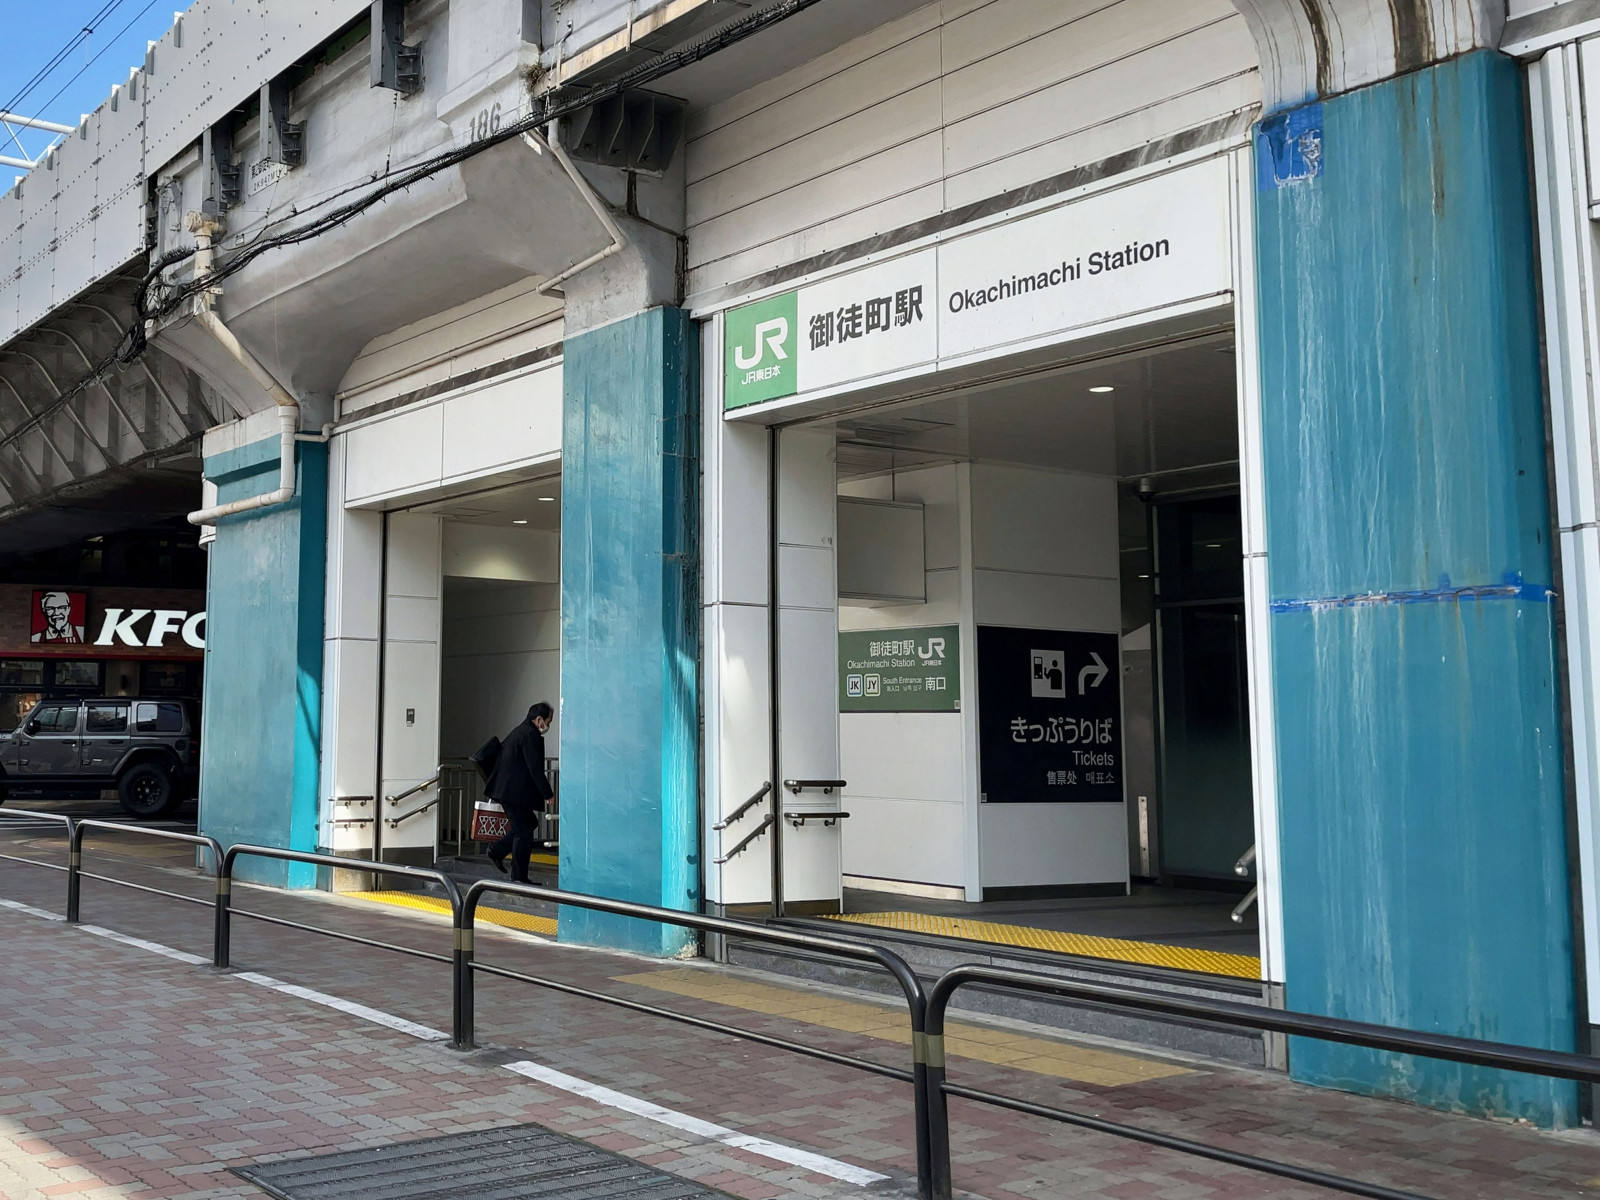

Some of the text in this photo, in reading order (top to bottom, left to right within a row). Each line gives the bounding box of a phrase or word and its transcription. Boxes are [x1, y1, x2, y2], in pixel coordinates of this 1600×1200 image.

[470, 102, 501, 142] 186
[948, 238, 1170, 314] Okachimachi Station
[809, 285, 924, 351] 御徒町駅
[734, 316, 789, 370] JR
[741, 364, 781, 385] JR東日本
[869, 640, 915, 657] 御徒町駅
[917, 637, 946, 659] JR
[847, 658, 916, 669] Okachimachi Station
[850, 680, 860, 690] JK
[867, 680, 877, 690] JY
[898, 676, 922, 684] Entrance
[924, 676, 946, 691] 南口
[1010, 716, 1113, 744] きっぷうりば
[1072, 750, 1114, 766] Tickets
[1046, 770, 1077, 785] 售票处
[1085, 771, 1115, 785] 매표소
